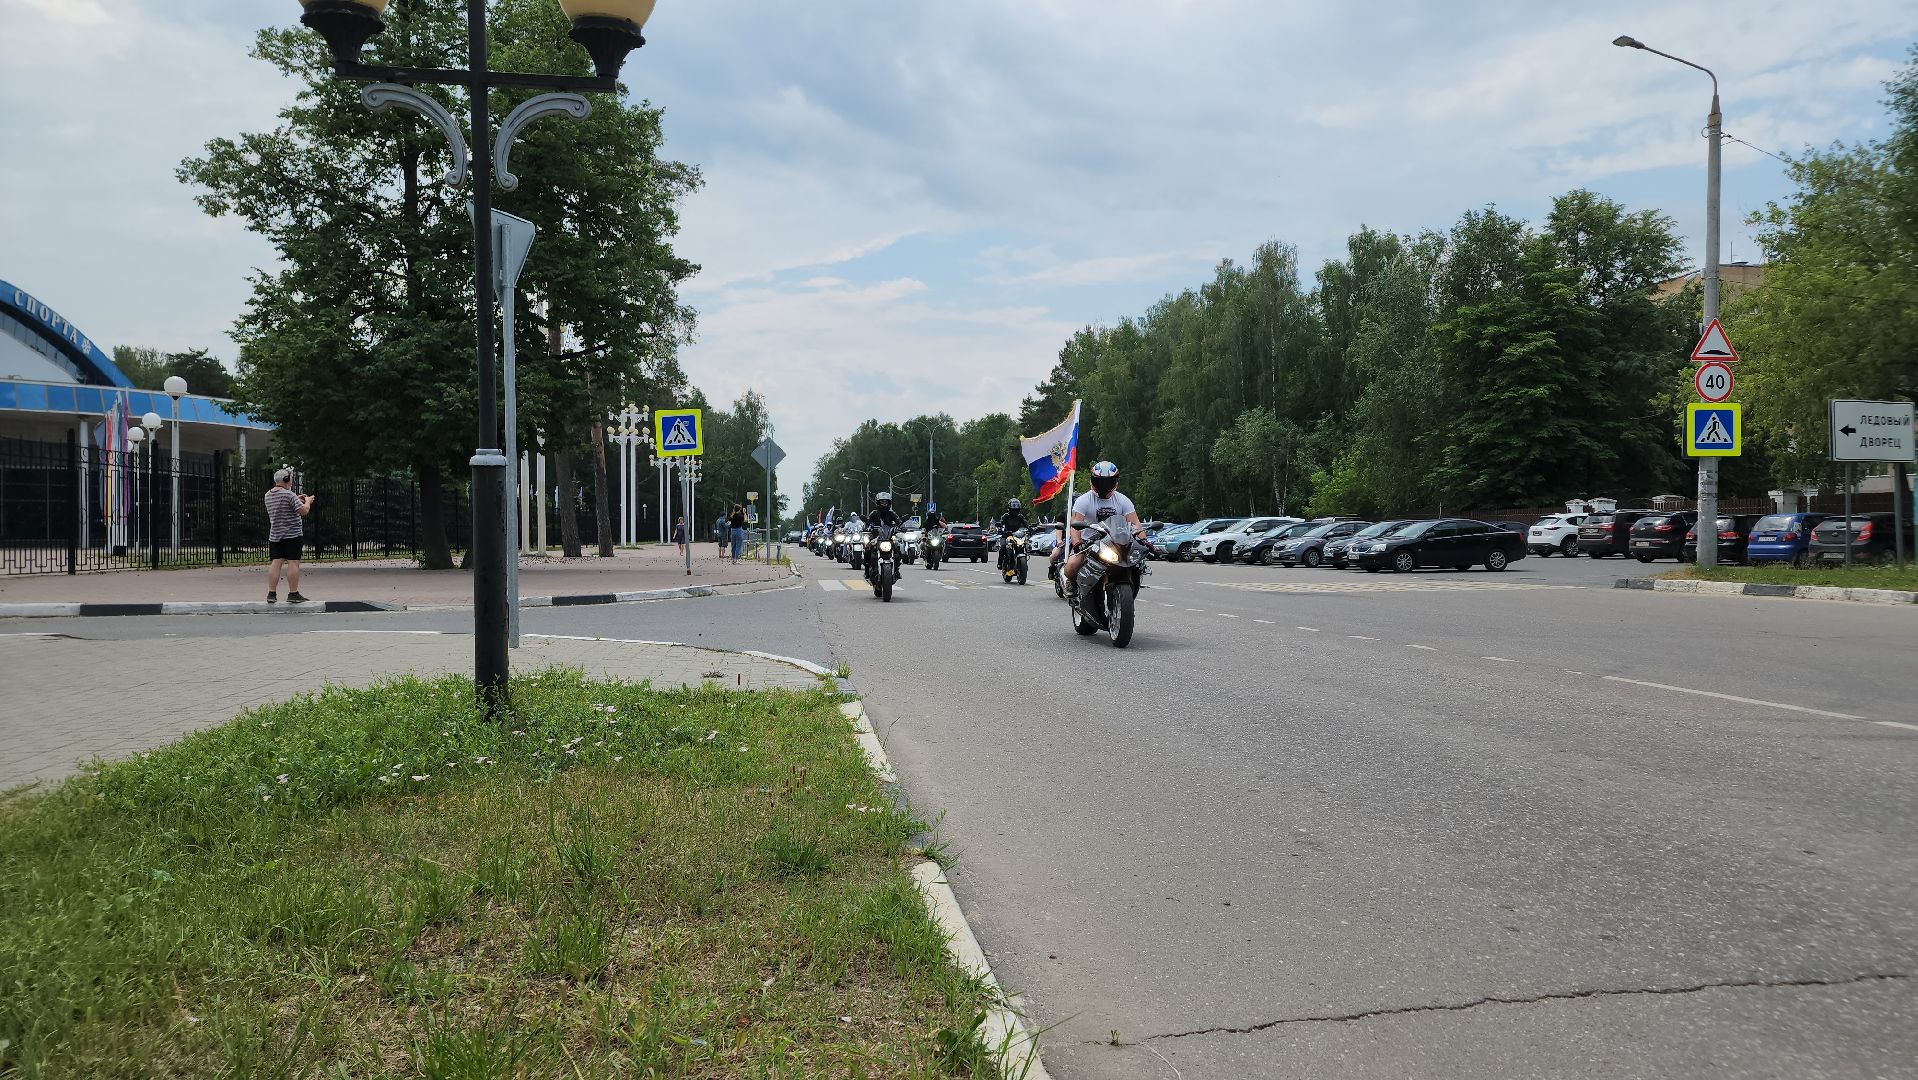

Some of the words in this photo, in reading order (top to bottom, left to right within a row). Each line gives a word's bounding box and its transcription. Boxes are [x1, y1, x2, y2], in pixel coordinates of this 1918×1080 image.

[14, 289, 78, 344] СПОРТА
[1705, 374, 1725, 389] 40
[1860, 414, 1911, 426] ЛЕДОВЫЙ
[1860, 436, 1902, 449] ДВОРЕЦ
